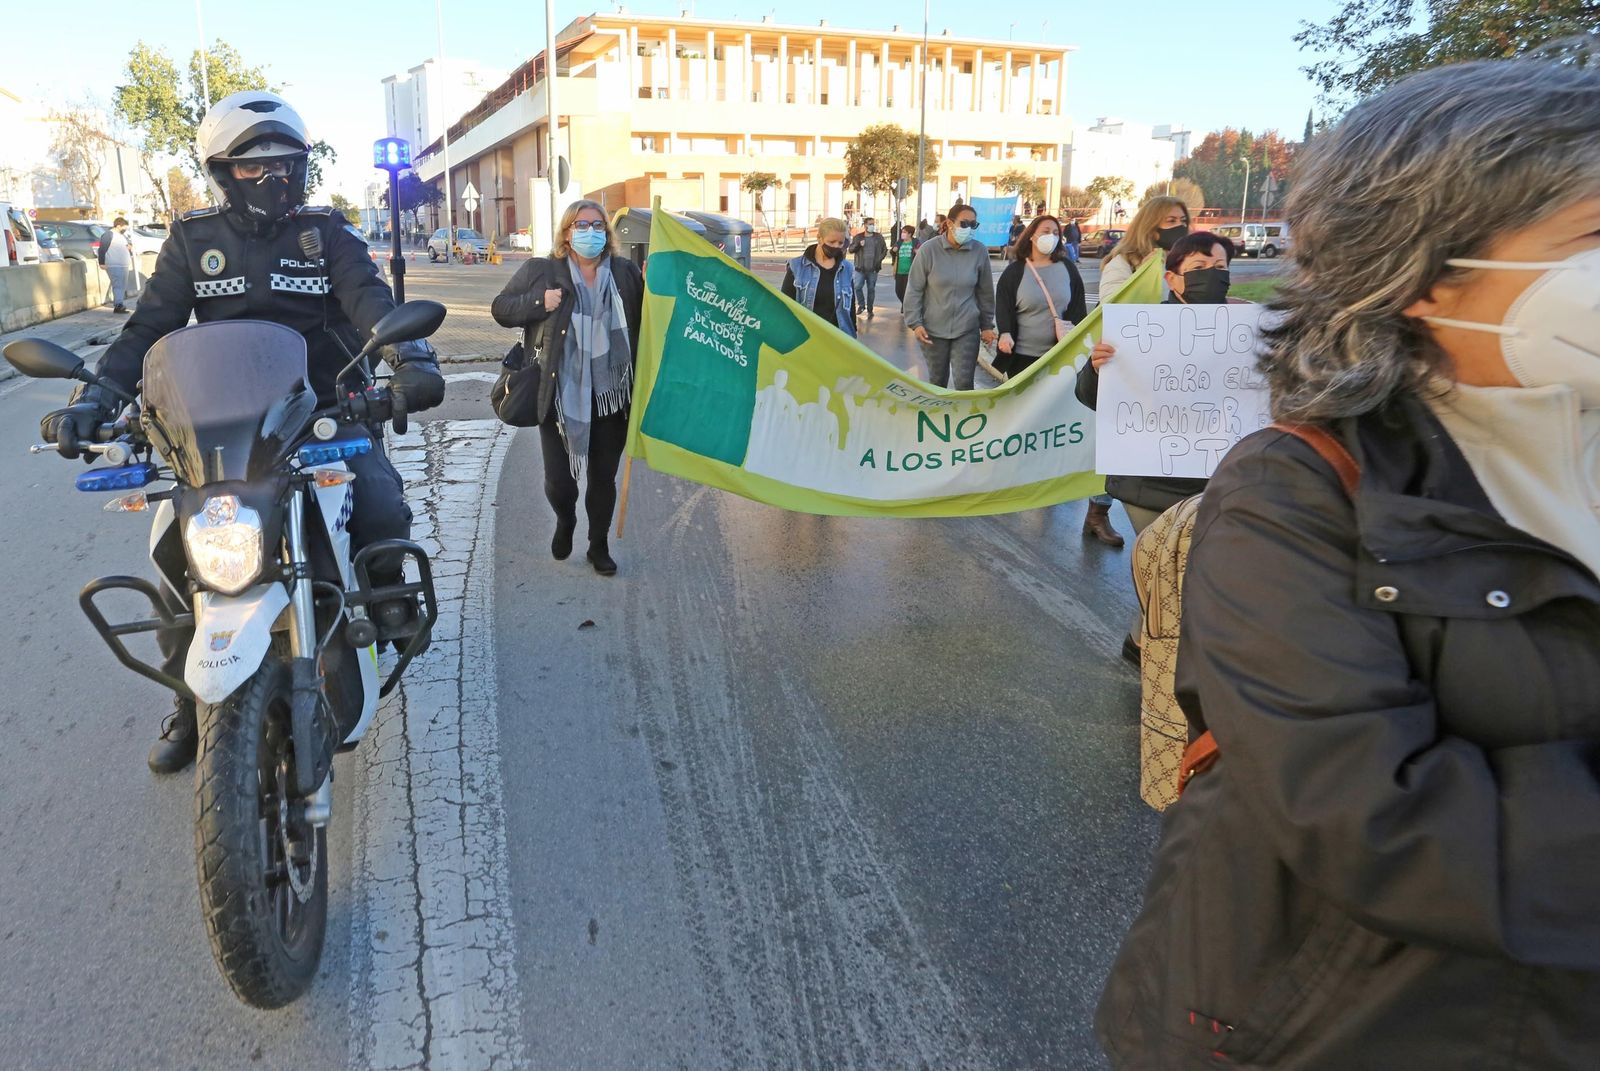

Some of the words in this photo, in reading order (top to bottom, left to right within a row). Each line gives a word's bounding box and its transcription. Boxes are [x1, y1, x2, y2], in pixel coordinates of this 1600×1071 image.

[885, 383, 913, 397] IES
[917, 410, 988, 443] NO
[859, 447, 876, 469] A
[886, 450, 943, 472] LOS
[951, 421, 1084, 467] RECORTES
[197, 655, 240, 668] POLICIA
